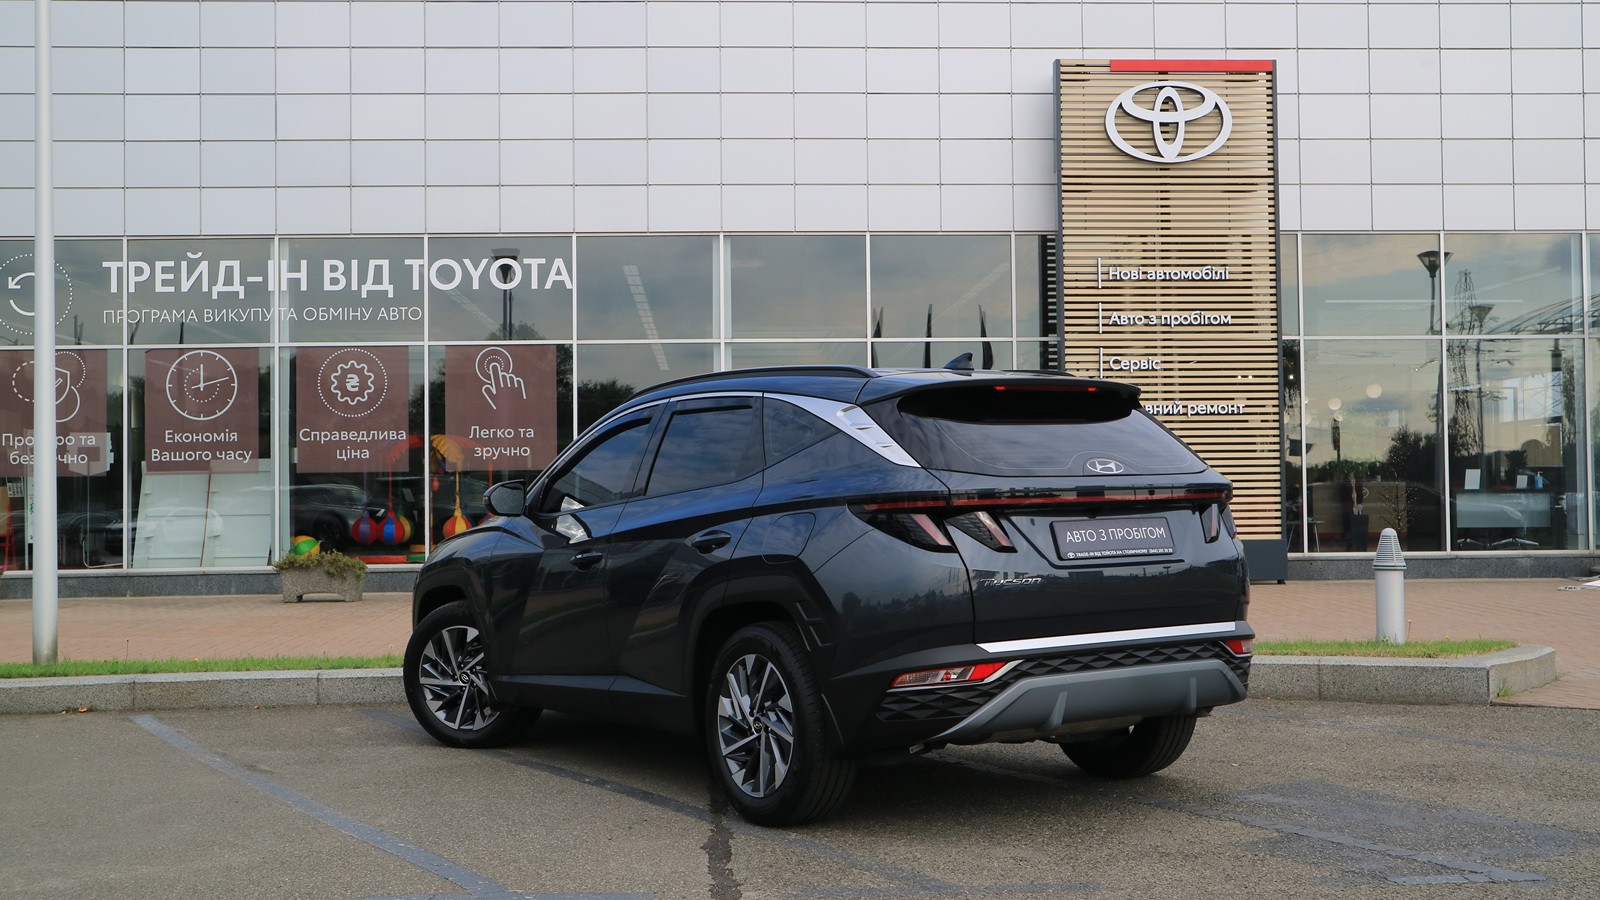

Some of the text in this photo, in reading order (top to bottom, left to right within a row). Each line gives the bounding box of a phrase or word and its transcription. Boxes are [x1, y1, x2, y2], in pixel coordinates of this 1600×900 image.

[102, 252, 573, 299] ТРЕЙД-ІН ВІД TOYOTA
[1108, 265, 1229, 280] Нові автомобілі
[103, 306, 422, 324] ПРОГРАМА ВИКУПУ ТА ОБМІНУ АВТО
[1108, 310, 1232, 328] Авто з пробігом
[1109, 356, 1161, 373] Сервіс
[1187, 403, 1245, 418] ремонт
[165, 429, 238, 443] Економія
[299, 428, 406, 444] Справедлива
[469, 425, 534, 439] Легко та
[79, 435, 96, 445] та
[9, 451, 88, 465] безчно
[151, 448, 252, 463] Вашого часу
[336, 446, 370, 461] ціна
[474, 446, 530, 460] зручно
[1066, 530, 1097, 543] АВТО
[1108, 527, 1166, 540] ПРОБІГОМ
[980, 577, 1042, 586] TUCSON
